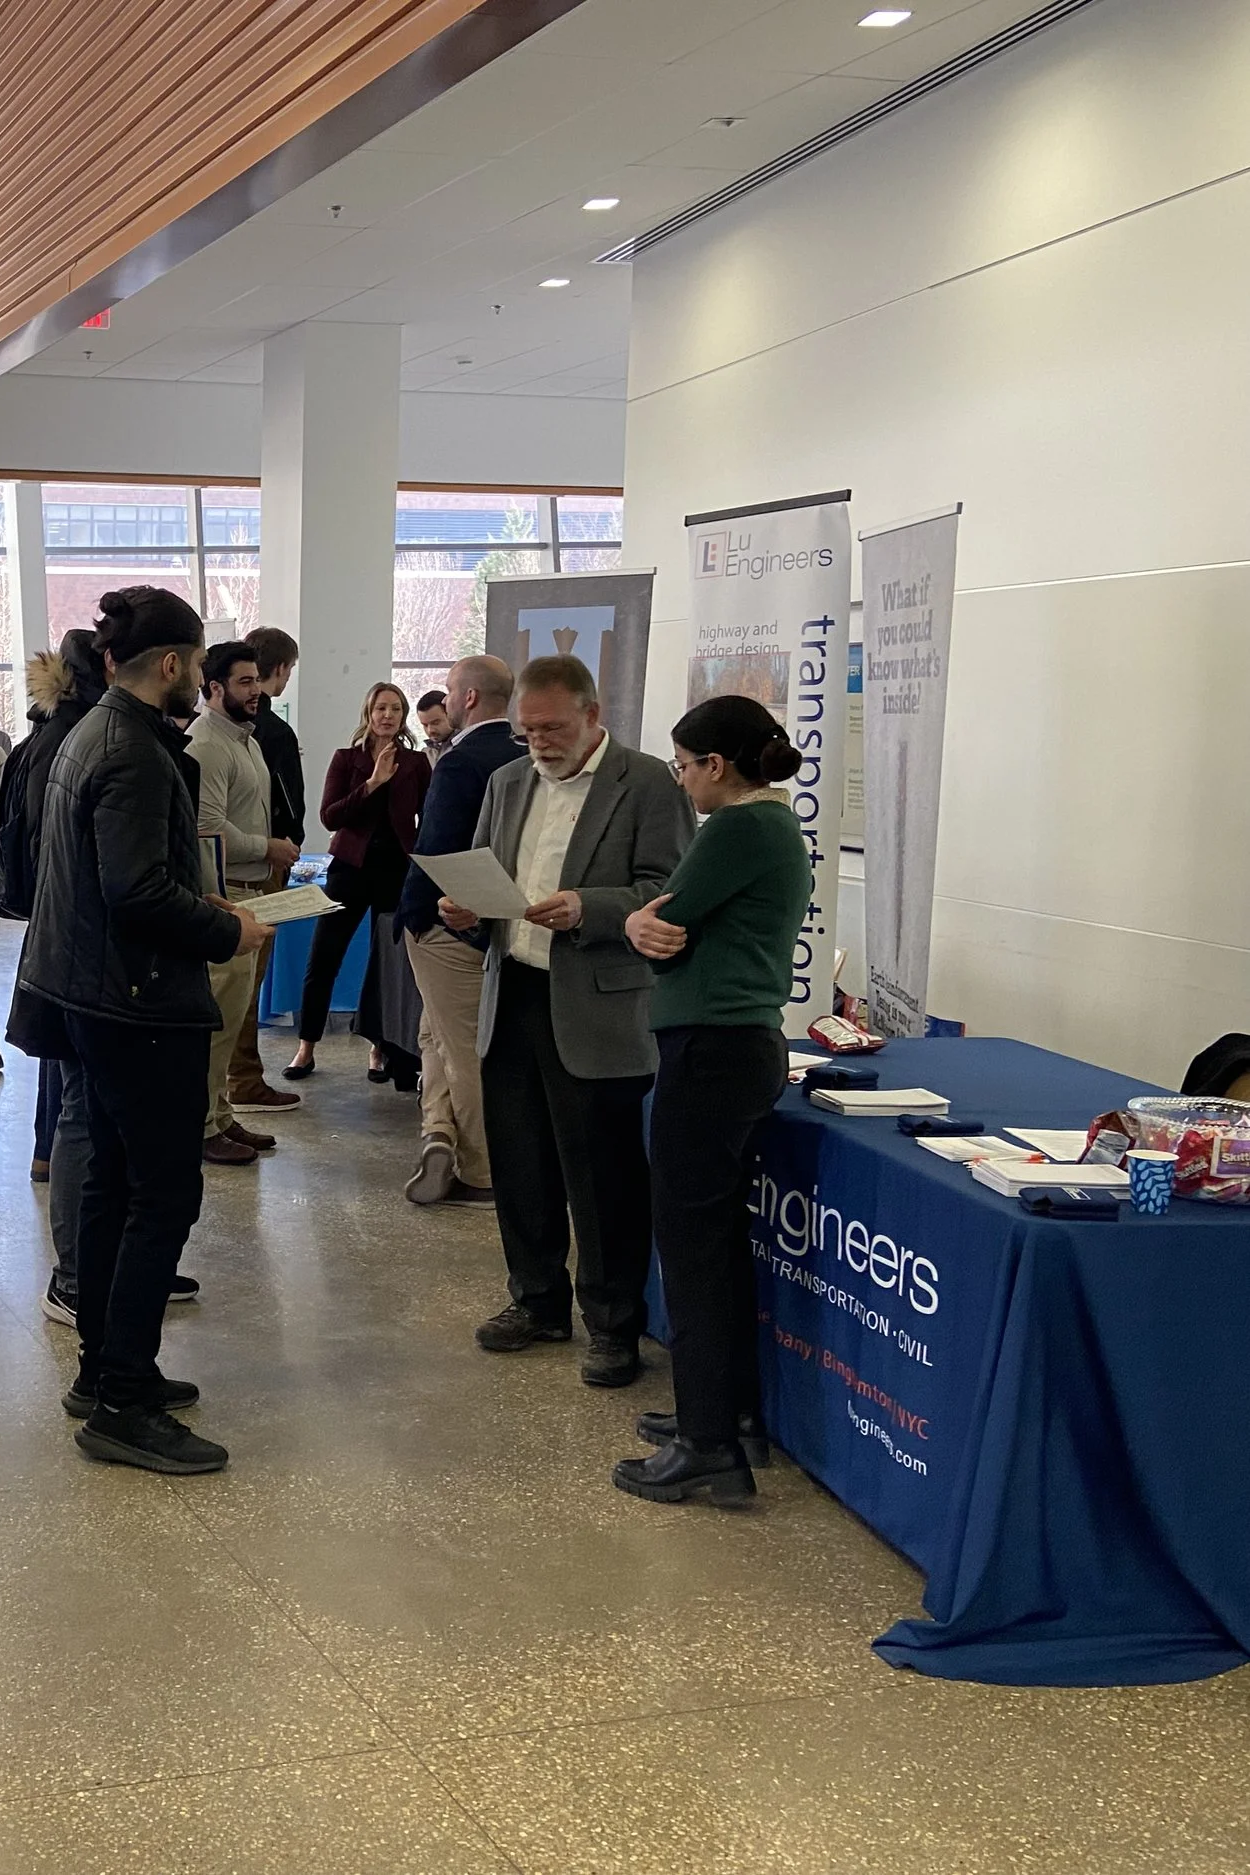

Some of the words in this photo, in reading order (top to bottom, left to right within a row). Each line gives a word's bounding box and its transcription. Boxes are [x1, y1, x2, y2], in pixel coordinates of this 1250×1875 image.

[727, 531, 751, 552] Lu
[726, 548, 833, 580] Engineers
[882, 579, 917, 612] What
[920, 573, 931, 606] if
[699, 614, 750, 642] highway
[753, 619, 777, 636] and
[877, 625, 898, 656] you
[899, 608, 933, 645] could
[695, 643, 733, 660] bridge
[736, 642, 779, 657] design
[868, 653, 899, 681] know
[900, 648, 941, 680] what's
[789, 615, 836, 1004] transporttion
[772, 1256, 889, 1337] TRANSPORTATION
[898, 1329, 934, 1367] CIVIL
